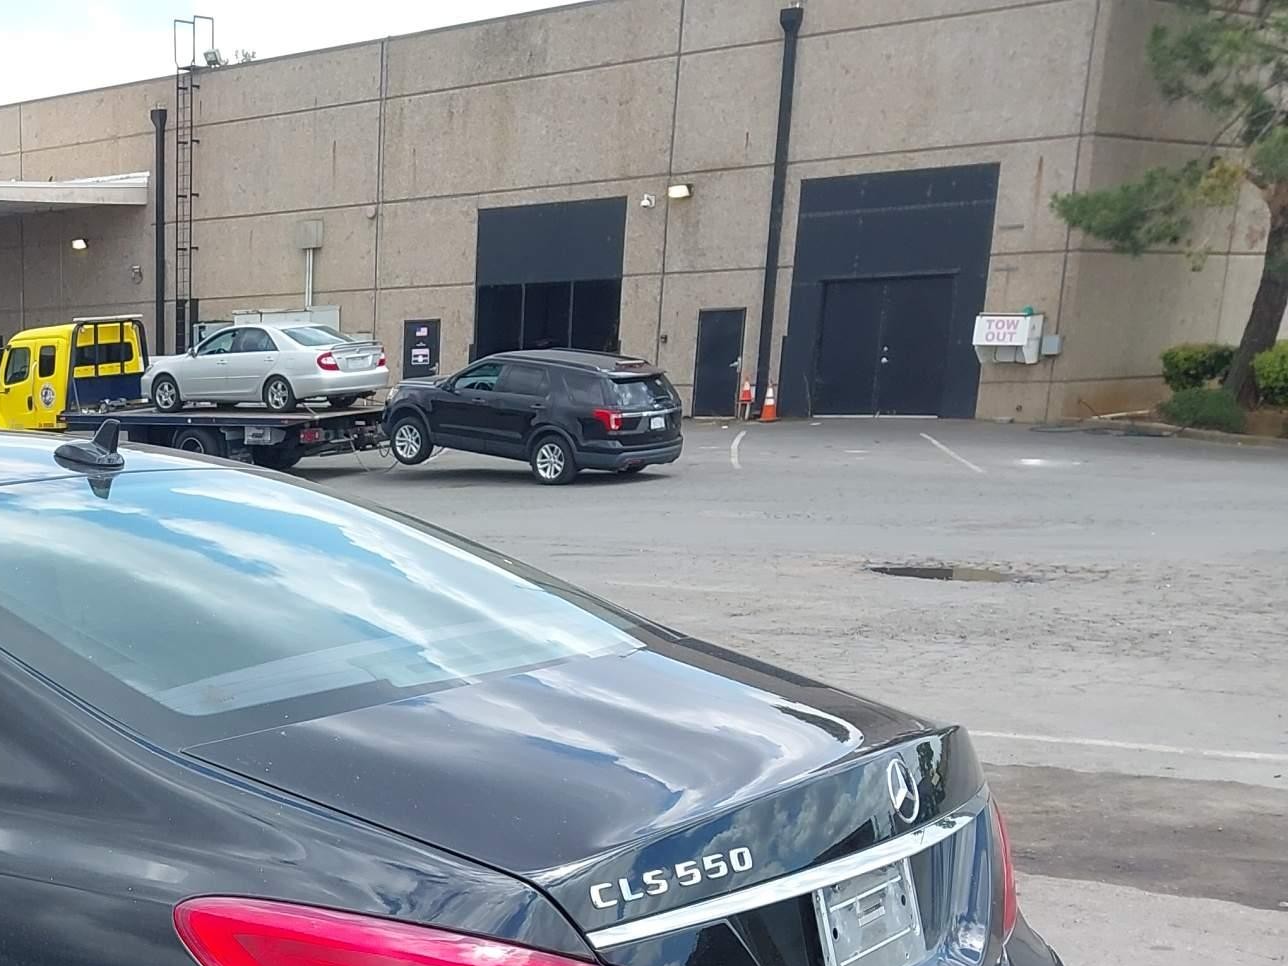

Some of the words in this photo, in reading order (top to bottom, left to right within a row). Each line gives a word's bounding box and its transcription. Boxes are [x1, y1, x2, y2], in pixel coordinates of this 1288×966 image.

[986, 319, 1020, 330] TOW
[985, 331, 1017, 342] OUT
[590, 869, 669, 909] CLS
[674, 846, 753, 886] 550
